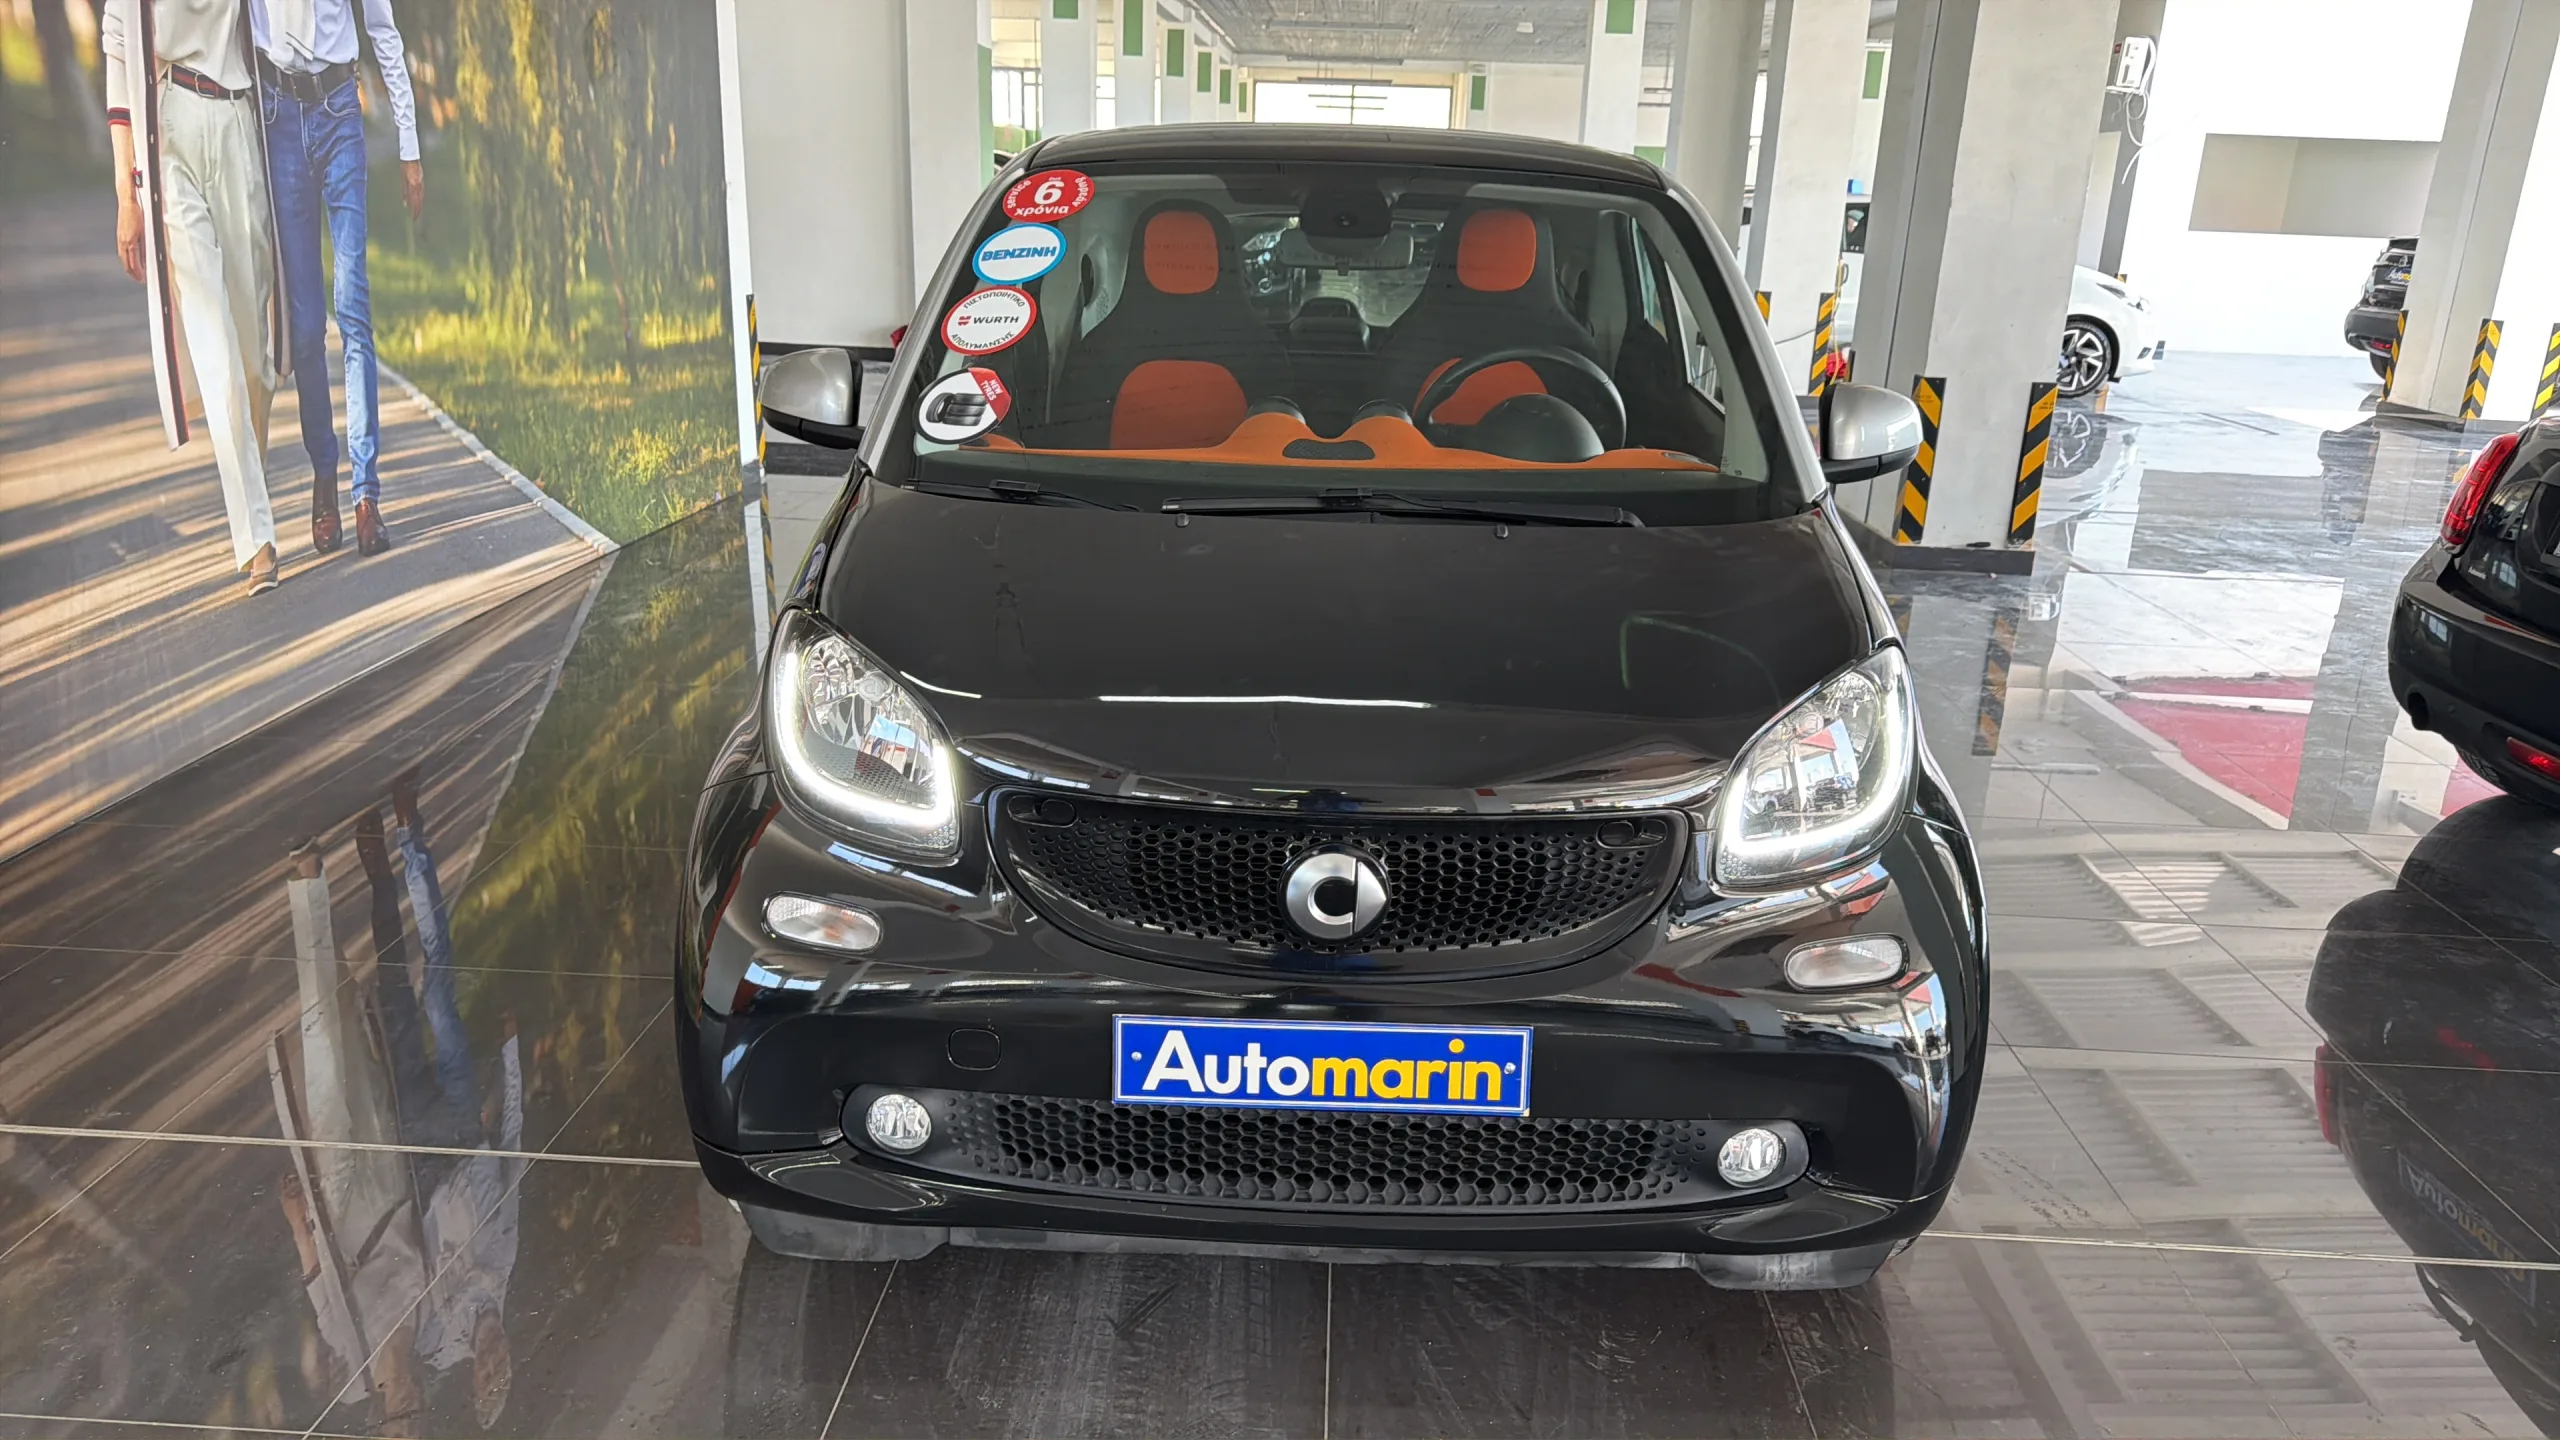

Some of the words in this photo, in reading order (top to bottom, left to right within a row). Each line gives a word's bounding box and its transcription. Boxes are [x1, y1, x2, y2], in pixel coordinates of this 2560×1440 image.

[1007, 180, 1032, 209] service
[1034, 181, 1065, 205] 6
[1014, 204, 1070, 217] χρόνια
[980, 380, 998, 401] TYRES
[988, 379, 1004, 395] NEW
[1141, 1029, 1501, 1101] Automarin
